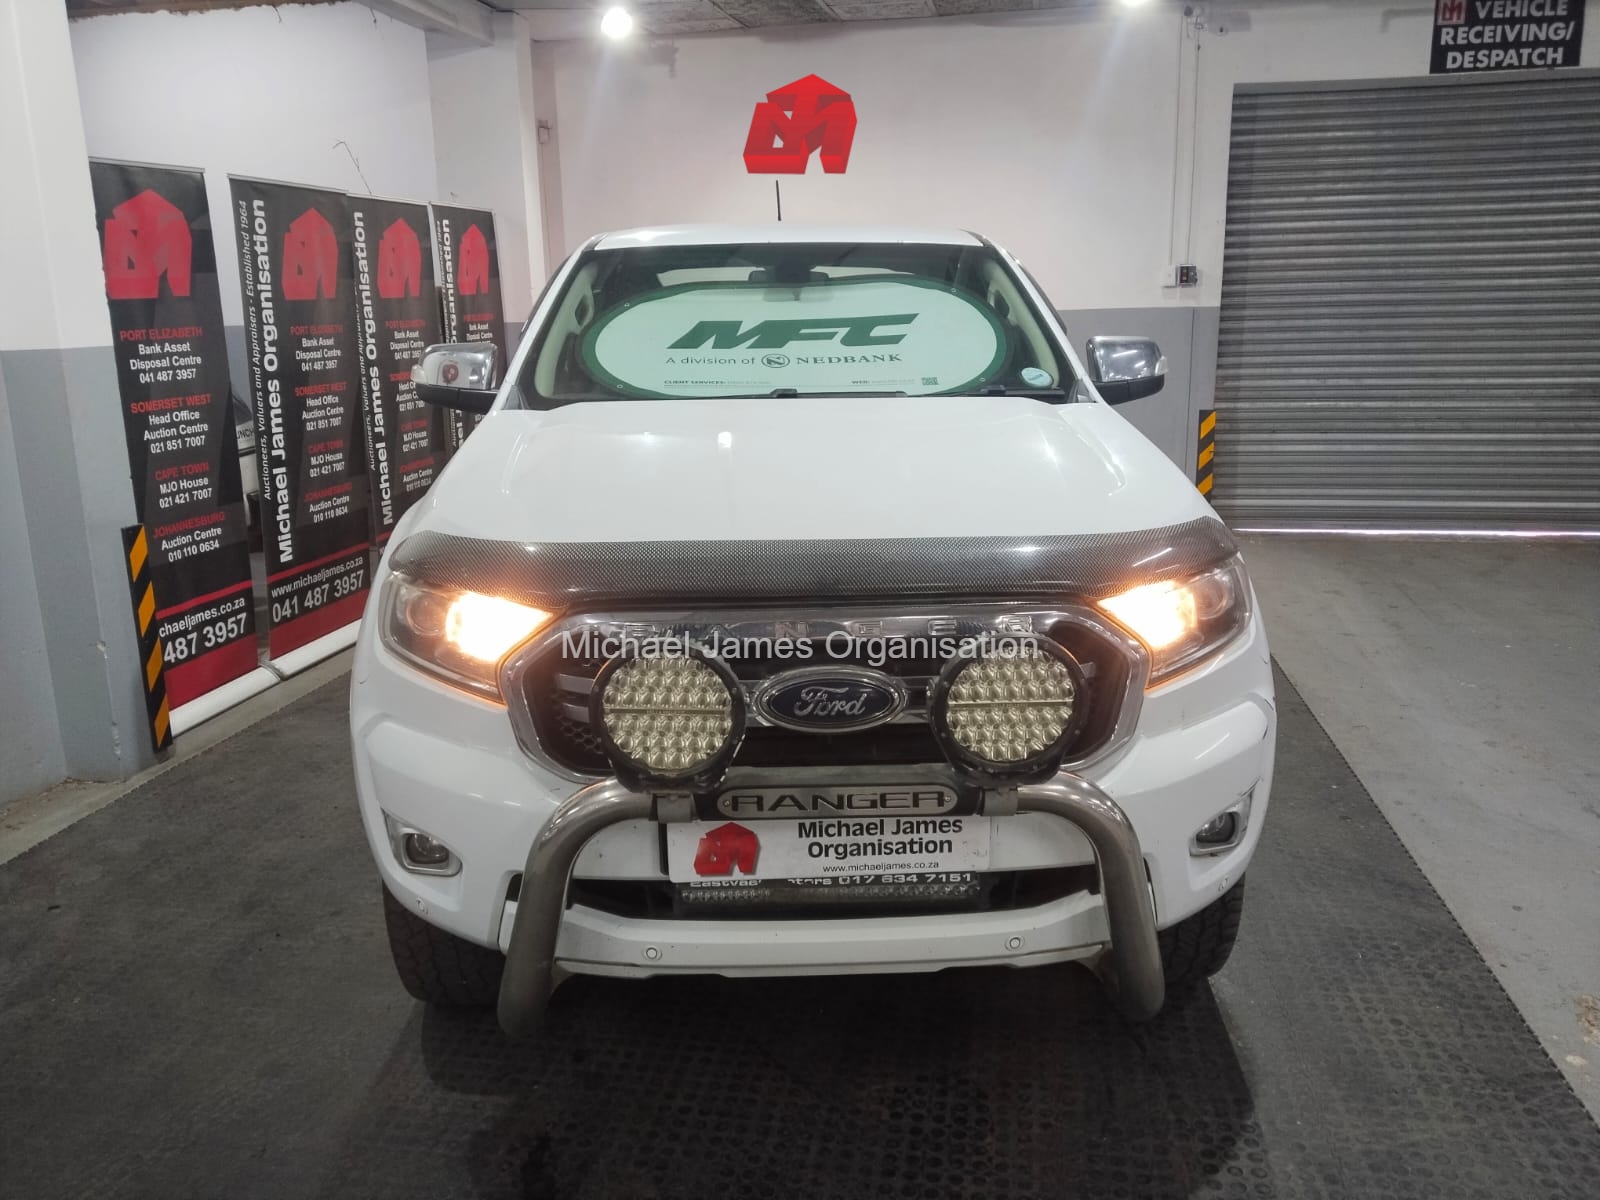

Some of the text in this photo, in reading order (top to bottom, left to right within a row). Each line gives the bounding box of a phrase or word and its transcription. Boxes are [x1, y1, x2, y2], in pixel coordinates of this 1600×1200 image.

[1475, 0, 1568, 19] VEHICLE
[1440, 21, 1575, 45] RECEIVING/
[1446, 47, 1564, 69] DESPATCH
[239, 200, 248, 228] 1964
[241, 231, 254, 296] Established
[120, 327, 203, 341] PORT ELIZABETH
[249, 306, 261, 365] Appraisers
[666, 313, 919, 349] MFC
[138, 342, 191, 355] Bank Asset
[302, 336, 334, 348] Bank Asset
[130, 356, 202, 370] Disposal Centre
[296, 348, 341, 360] Disposal Centre
[680, 356, 736, 364] division
[741, 356, 756, 364] of
[796, 354, 903, 365] NEDBANK
[140, 368, 196, 384] 041 487 3957
[253, 366, 262, 388] and
[302, 362, 312, 372] 041
[354, 212, 393, 525] Michael James Organisation
[252, 200, 293, 563] Michael James Organisation
[130, 394, 212, 414] SOMERSET WEST
[256, 390, 265, 431] Valuers
[306, 395, 339, 407] Head Office
[149, 410, 200, 426] Head Office
[302, 406, 344, 420] Auction Centre
[144, 423, 208, 440] Auction Centre
[306, 422, 316, 431] 021
[150, 435, 206, 454] 021 851 7007
[260, 435, 271, 500] Auctioneers,
[311, 454, 324, 466] MJO
[155, 467, 178, 481] CAPE
[160, 478, 208, 494] MJO House
[160, 488, 212, 508] 021 421 7007
[309, 496, 350, 512] Auction Centre
[161, 527, 222, 551] Auction Centre
[168, 540, 220, 562] 010 110 0634
[271, 556, 364, 599] www.michaeljames.co.za
[272, 569, 364, 623] 041 487 3957
[164, 612, 247, 663] 487 3957
[793, 685, 867, 718] Ford
[731, 791, 945, 812] RANGER
[798, 818, 963, 839] Michael James
[807, 837, 952, 860] Organisation
[823, 861, 939, 872] www.michaeljames.co.za
[925, 873, 971, 882] 7151
